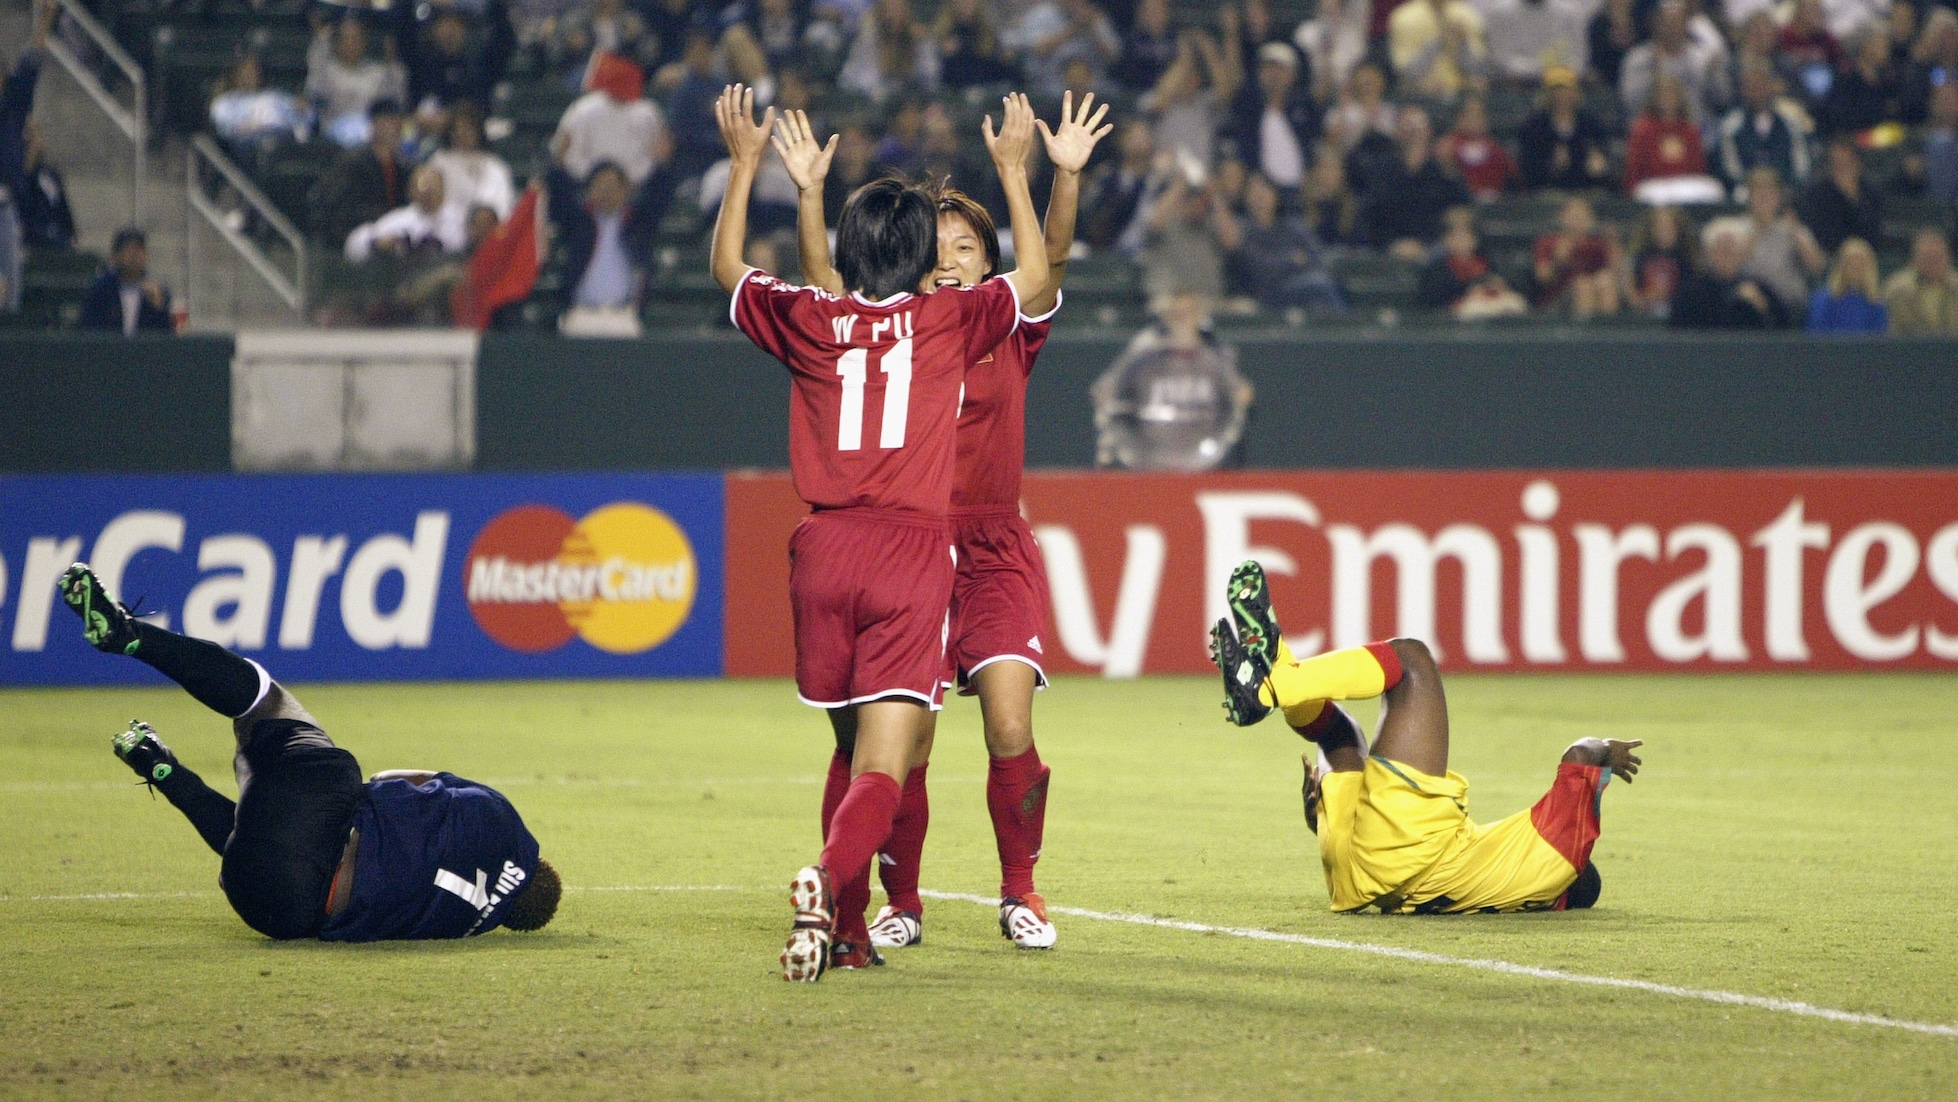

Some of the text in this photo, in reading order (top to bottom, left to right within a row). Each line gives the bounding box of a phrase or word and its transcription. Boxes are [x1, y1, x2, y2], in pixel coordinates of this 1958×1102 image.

[831, 314, 858, 343] W
[836, 338, 913, 450] 11
[0, 511, 448, 651] rCard
[468, 556, 686, 603] MasterCard
[433, 867, 489, 911] 1
